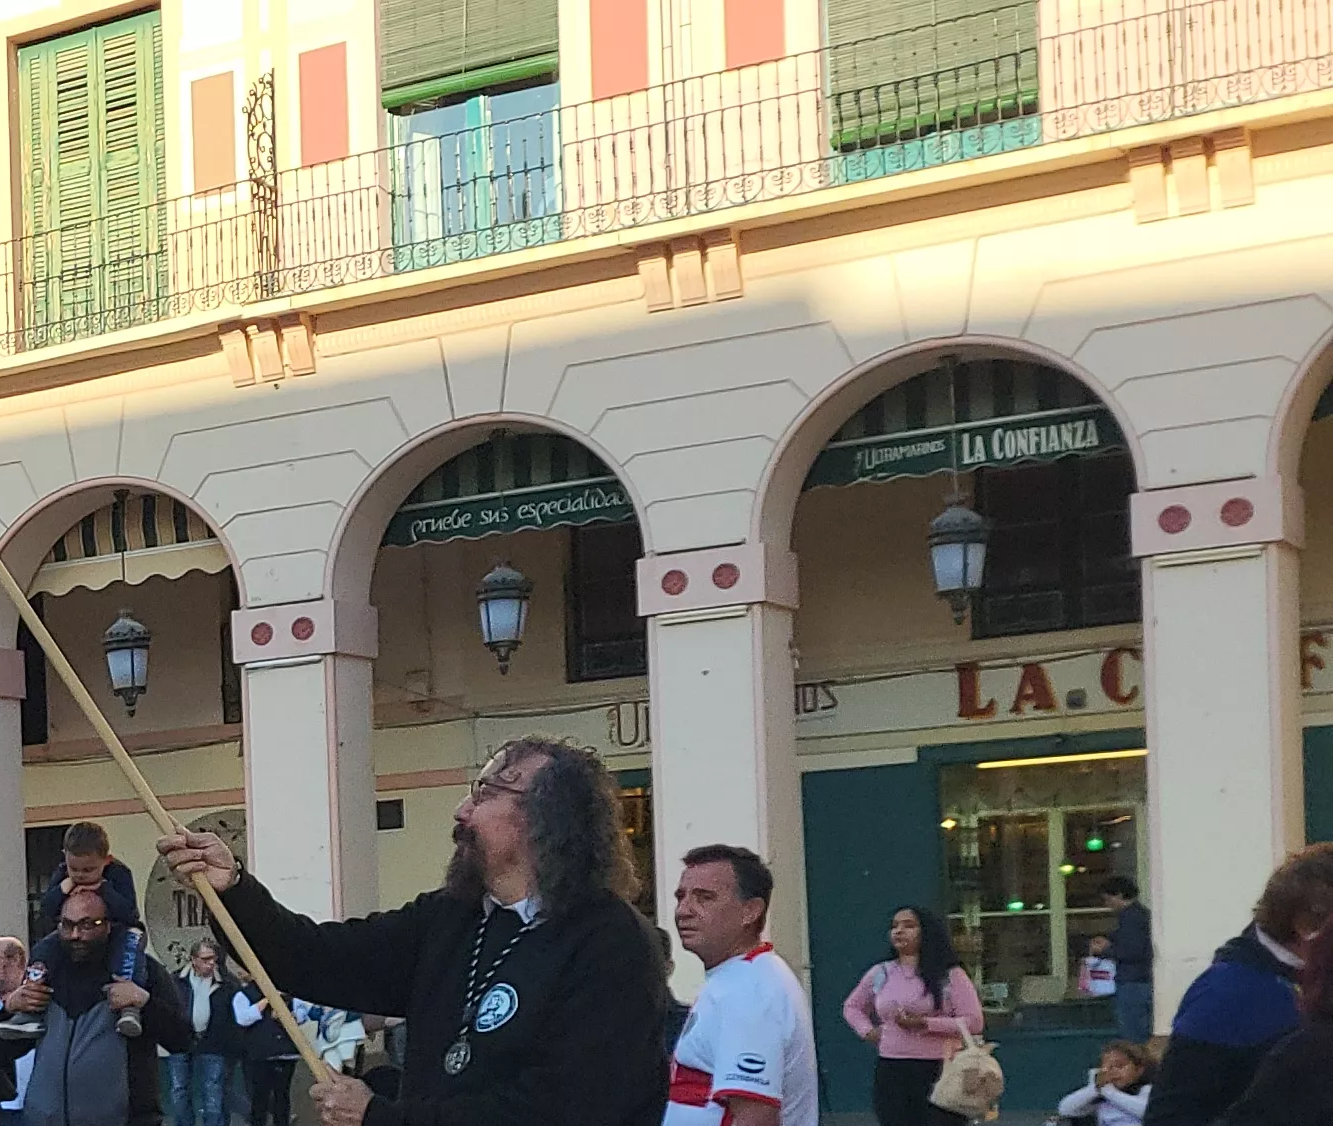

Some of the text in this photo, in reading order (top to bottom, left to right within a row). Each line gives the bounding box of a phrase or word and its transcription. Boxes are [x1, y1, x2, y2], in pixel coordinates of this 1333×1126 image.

[961, 431, 987, 466] LA
[991, 418, 1100, 461] CONFIANZA
[410, 507, 474, 541] pruebe
[479, 506, 510, 525] sus
